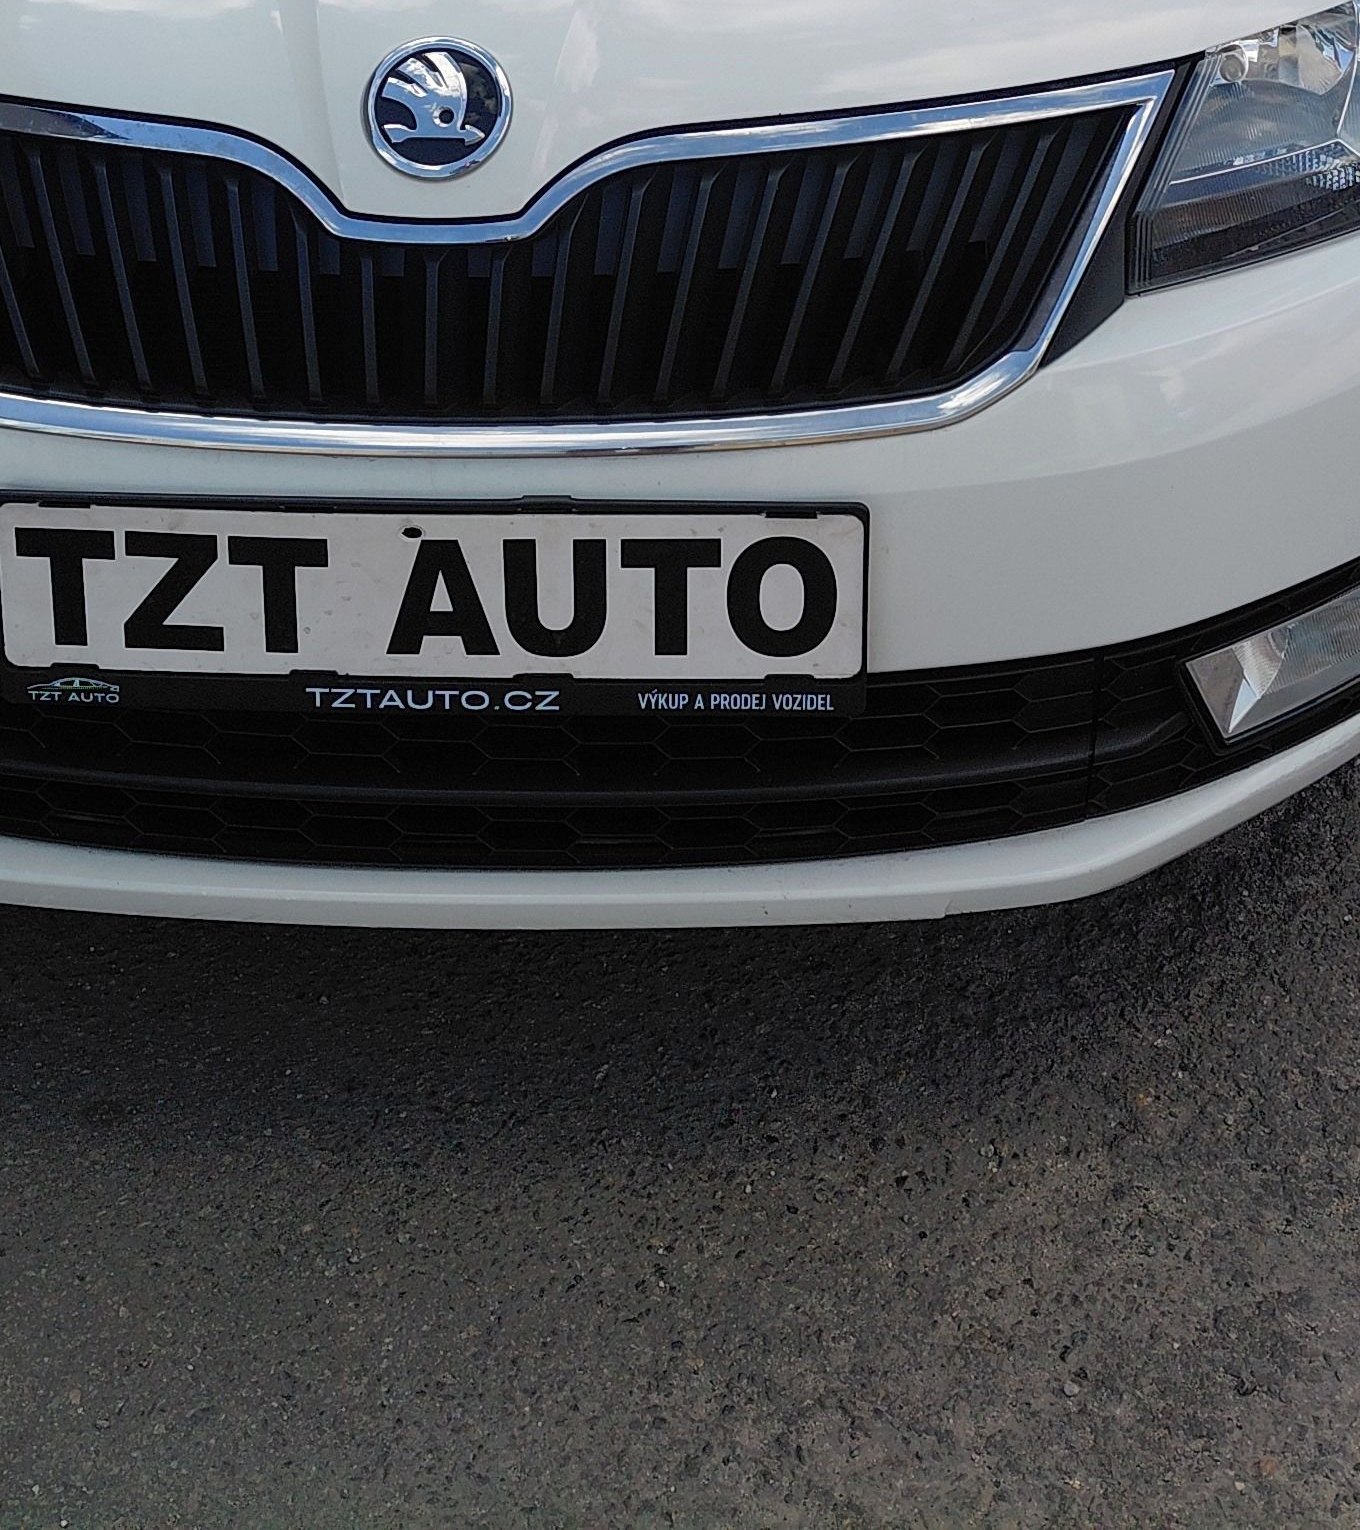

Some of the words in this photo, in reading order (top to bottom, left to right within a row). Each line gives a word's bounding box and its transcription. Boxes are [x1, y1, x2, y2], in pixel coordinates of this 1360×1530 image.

[15, 527, 328, 653] TZT
[386, 537, 837, 657] AUTO
[27, 690, 62, 701] TZT
[67, 692, 120, 704] AUTO
[305, 687, 560, 711] TZTAUTO.CZ
[638, 688, 689, 710] VÝKUP
[694, 693, 705, 710] A
[710, 693, 767, 711] PRODEJ
[772, 693, 835, 711] VOZIDEL
